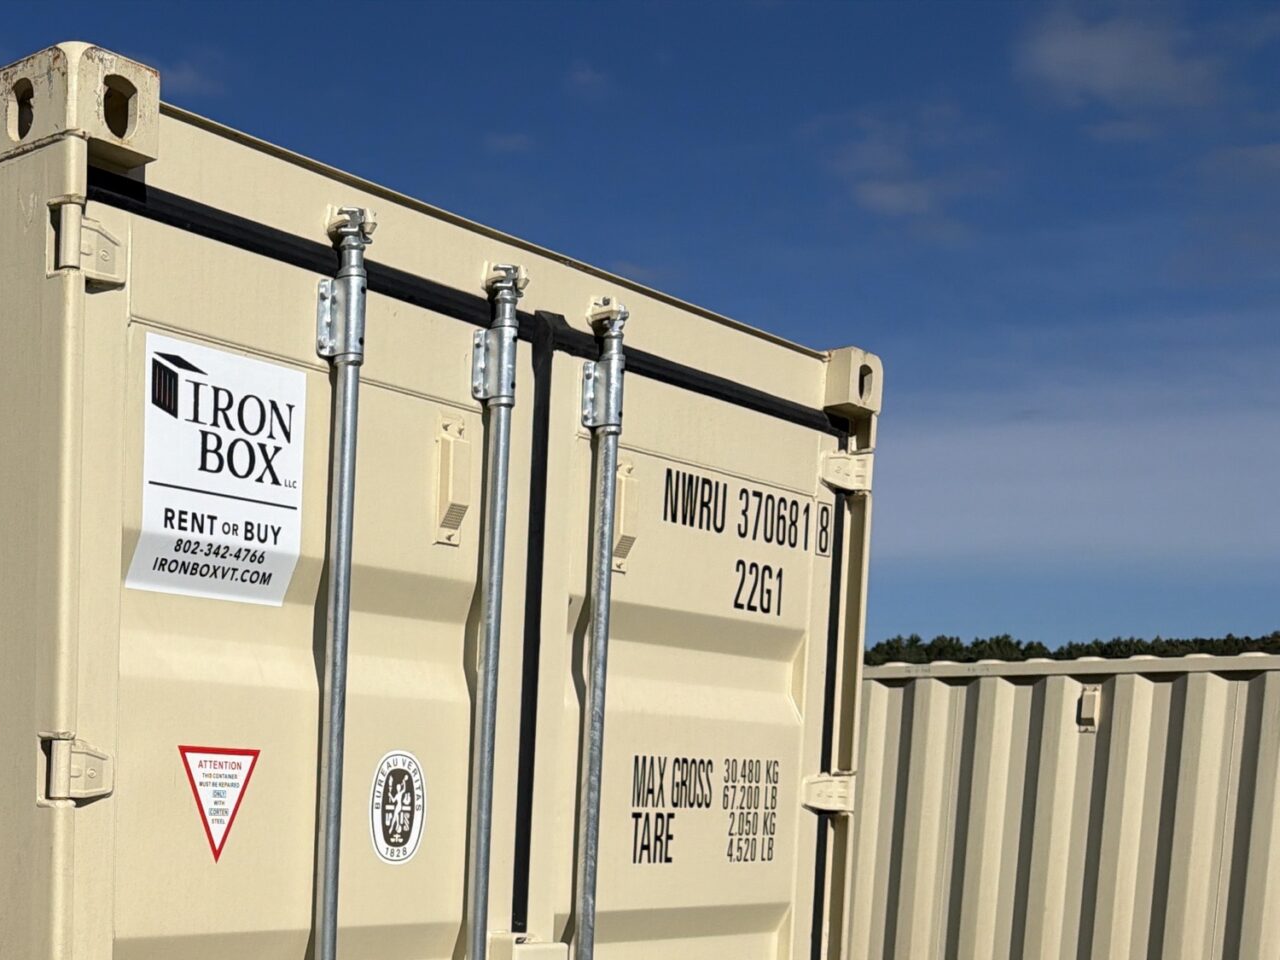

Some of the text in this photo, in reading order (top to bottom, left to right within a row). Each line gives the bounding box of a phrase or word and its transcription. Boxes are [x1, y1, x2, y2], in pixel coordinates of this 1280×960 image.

[184, 379, 295, 444] IRON
[197, 429, 283, 486] BOX
[284, 479, 297, 489] LLC
[663, 467, 830, 553] NWRU 370681 8
[163, 507, 282, 545] RENT OR BUY
[174, 538, 266, 564] 802-342-4766
[152, 556, 273, 586] IRONBOXVT.COM
[733, 559, 783, 616] 22G1
[198, 760, 242, 770] ATTENTION
[723, 759, 779, 784] 30.480 KG
[374, 758, 422, 812] BUREAU VERITAS
[632, 755, 713, 808] MAX GROSS
[722, 785, 777, 810] 67.200 LB
[631, 812, 675, 864] TARE
[728, 812, 776, 836] 2.050 KG
[385, 847, 407, 858] 1828
[726, 838, 774, 862] 4.520 LB
